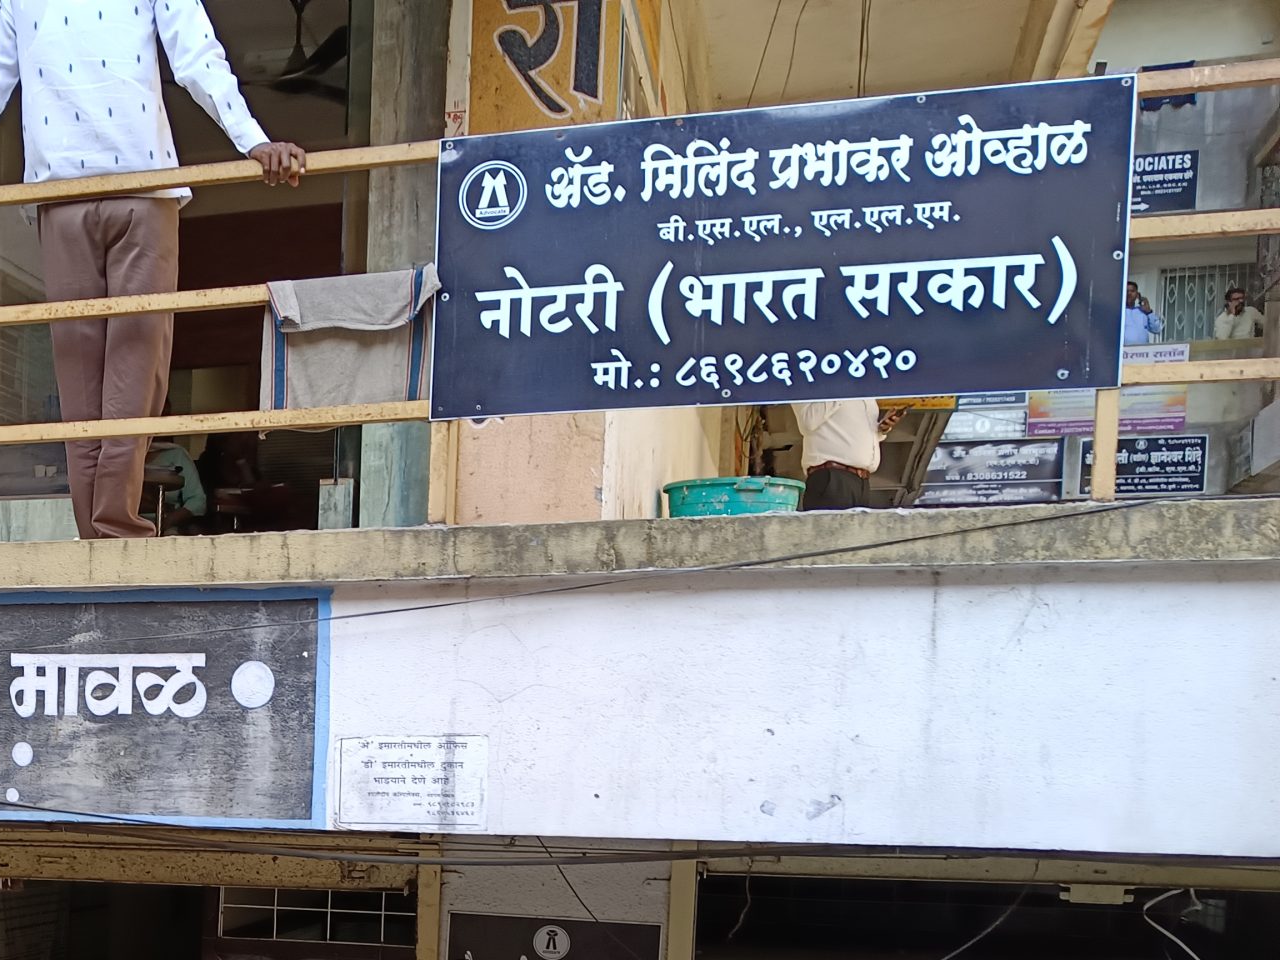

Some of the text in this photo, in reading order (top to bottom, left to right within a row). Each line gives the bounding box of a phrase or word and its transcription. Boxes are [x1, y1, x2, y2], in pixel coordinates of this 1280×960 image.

[641, 137, 757, 201] मिलिंद
[767, 131, 913, 190] प्रभाकर
[924, 114, 1091, 177] ओव्हाळ
[476, 234, 1078, 345] नोटरी (भारत सरकार)
[675, 344, 918, 389] ८६९८६२०४२०
[10, 651, 207, 717] मावळ
